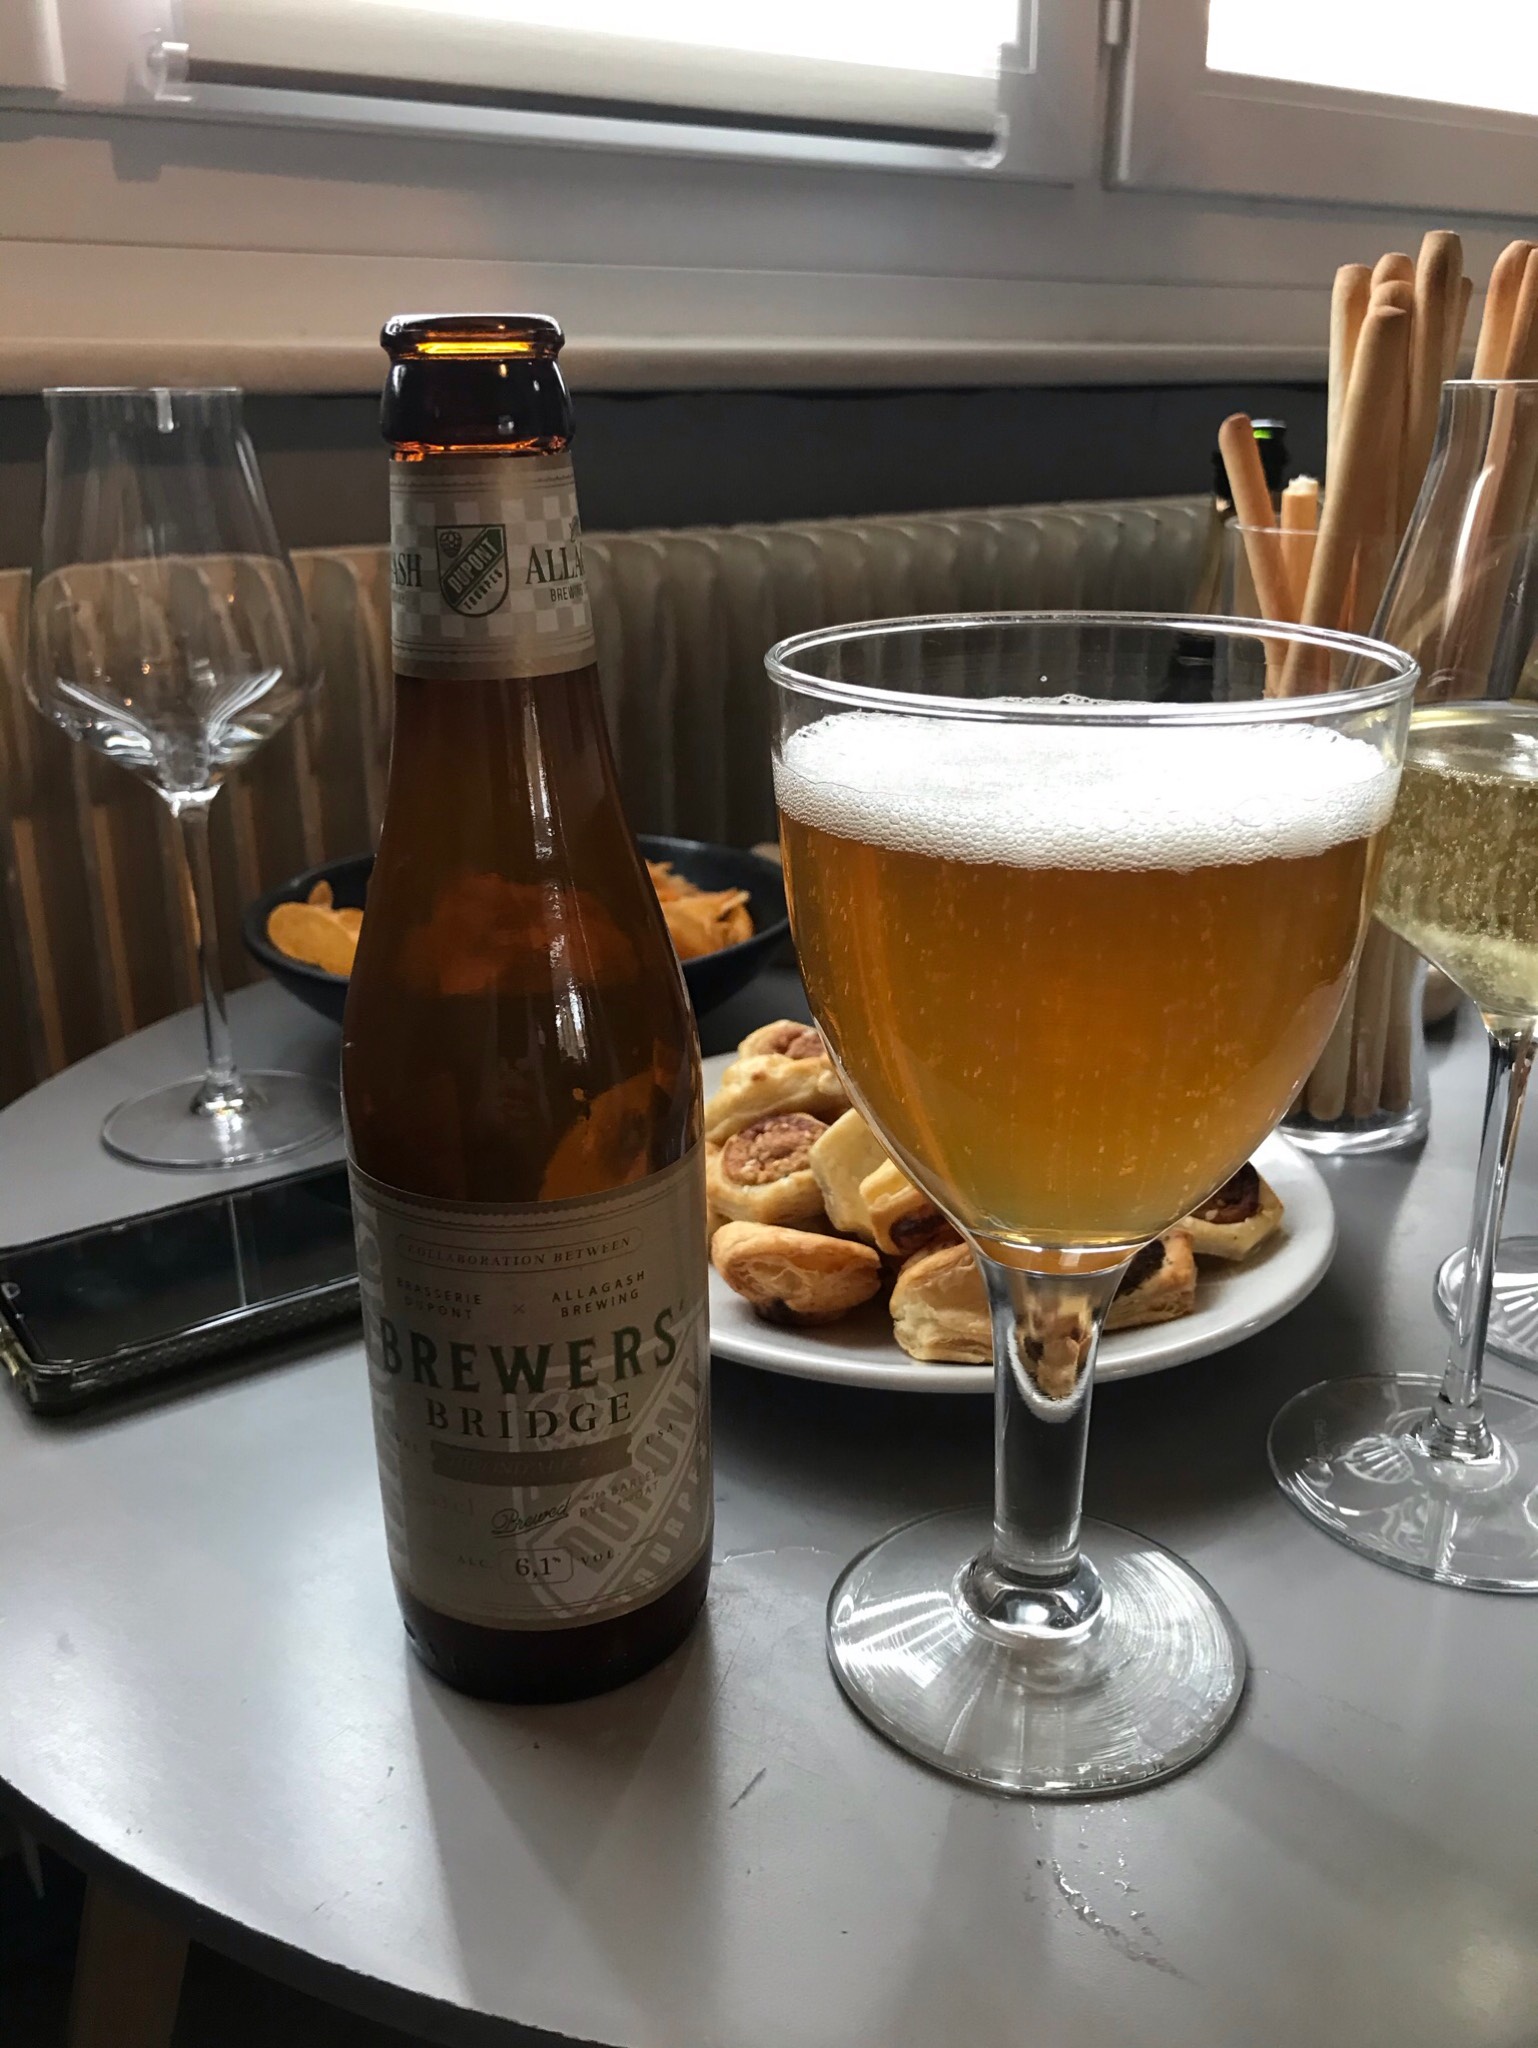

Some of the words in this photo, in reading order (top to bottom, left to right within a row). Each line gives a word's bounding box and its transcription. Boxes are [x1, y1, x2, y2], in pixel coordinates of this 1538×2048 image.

[447, 538, 499, 594] DUPONT
[407, 1243, 545, 1267] COLLABORATION
[553, 1236, 631, 1263] BETWEEN
[396, 1276, 483, 1306] BRASSERIE
[551, 1270, 646, 1303] ALLAGASH
[404, 1295, 472, 1320] DUPONT
[561, 1288, 640, 1318] BREWING
[425, 1392, 632, 1439] BRIDGE
[646, 1423, 674, 1445] USA
[611, 1467, 659, 1496] BARLEY
[491, 1495, 572, 1536] Brewed
